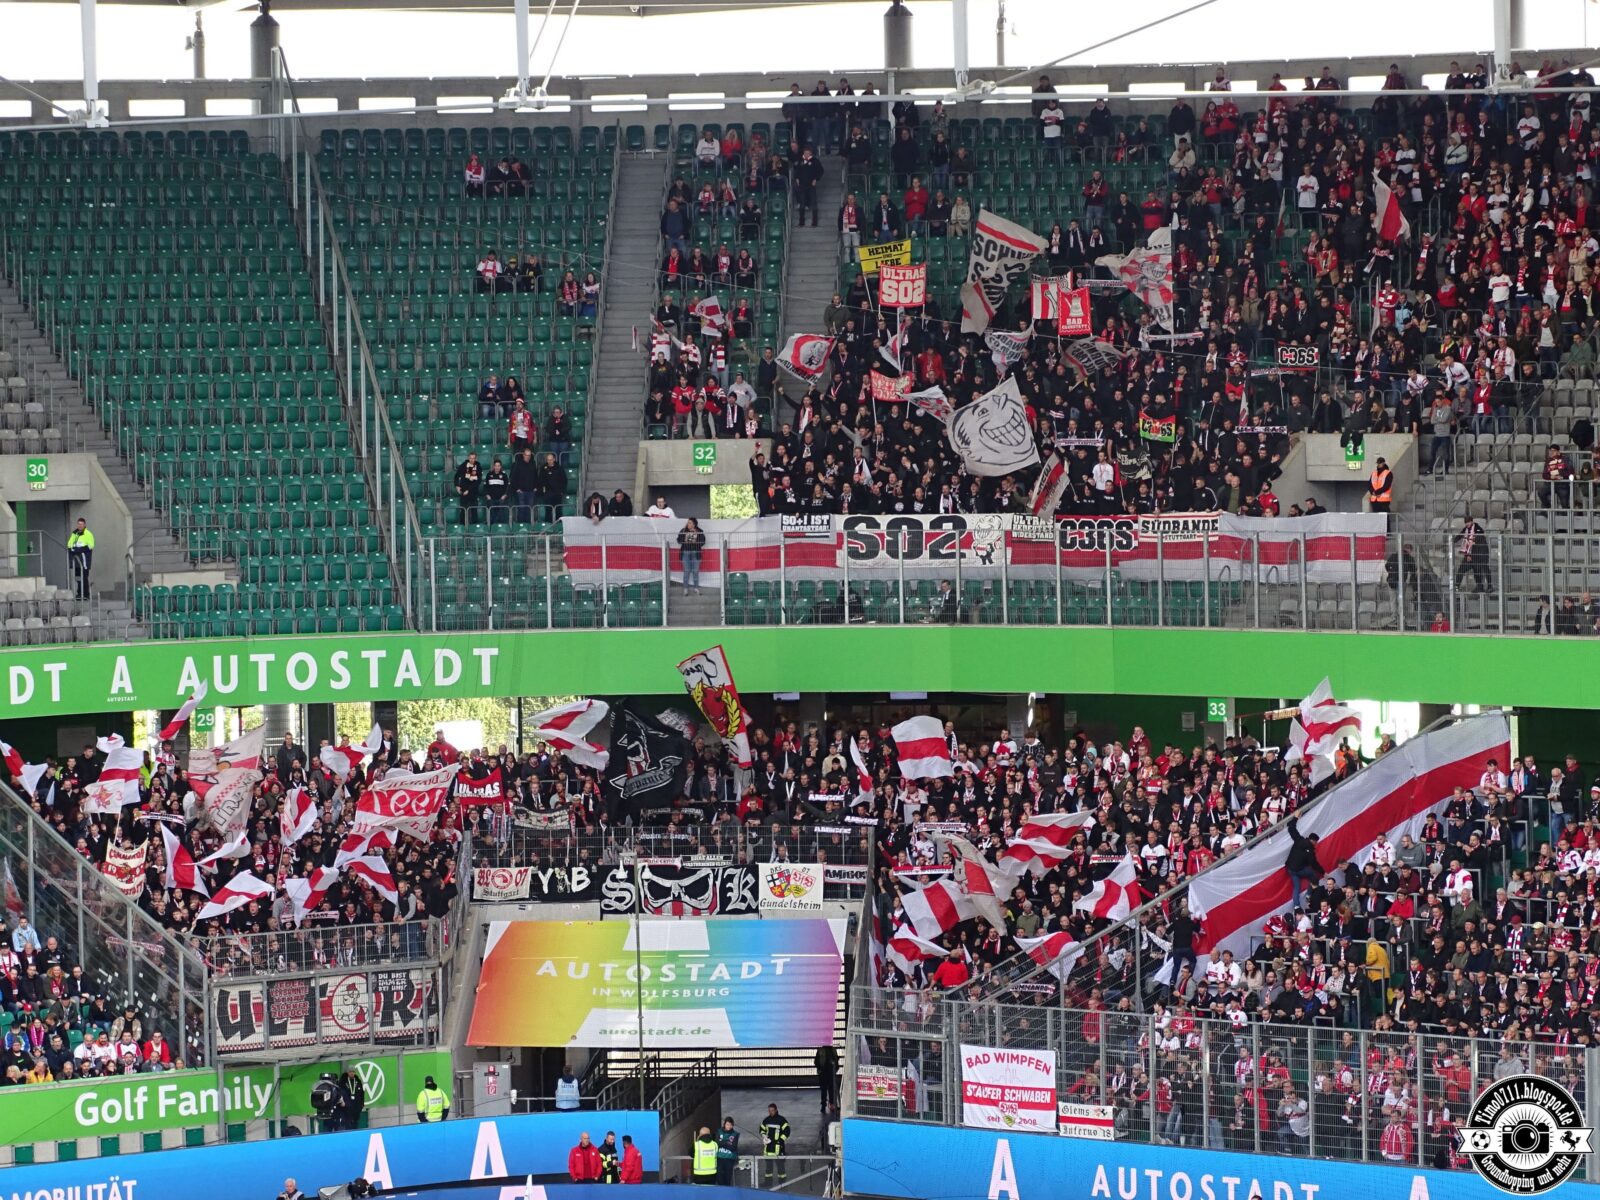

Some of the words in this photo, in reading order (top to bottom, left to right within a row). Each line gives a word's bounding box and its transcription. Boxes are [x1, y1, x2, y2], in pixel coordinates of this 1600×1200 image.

[868, 243, 904, 256] HEIMAT
[875, 258, 902, 269] LIEBE
[882, 267, 926, 280] ULTRAS
[695, 447, 714, 459] 32
[29, 464, 46, 476] 30
[811, 515, 829, 525] IST
[1141, 518, 1219, 534] SÜDBANDE
[1061, 519, 1135, 550] C36S
[111, 656, 133, 694] A
[177, 648, 498, 695] AUTOSTADT
[1209, 703, 1226, 715] 33
[197, 714, 214, 727] 29
[482, 888, 519, 899] Stuttgart
[760, 898, 821, 910] Gundelsheim
[536, 958, 790, 982] AUTOSTADT
[593, 987, 612, 996] IN
[620, 987, 730, 998] WOLFSBURG
[599, 1026, 711, 1036] autostadt.de
[966, 1053, 990, 1068] BAD
[994, 1052, 1051, 1075] WIMPFEN
[966, 1084, 1002, 1100] STAUFER
[1004, 1088, 1051, 1103] SCHWABEN
[75, 1086, 148, 1126] Golf
[158, 1076, 273, 1117] Family
[1061, 1105, 1090, 1116] Glems
[1063, 1125, 1098, 1136] Inferno
[363, 1133, 394, 1189] A
[470, 1121, 508, 1179] A
[988, 1139, 1020, 1200] A
